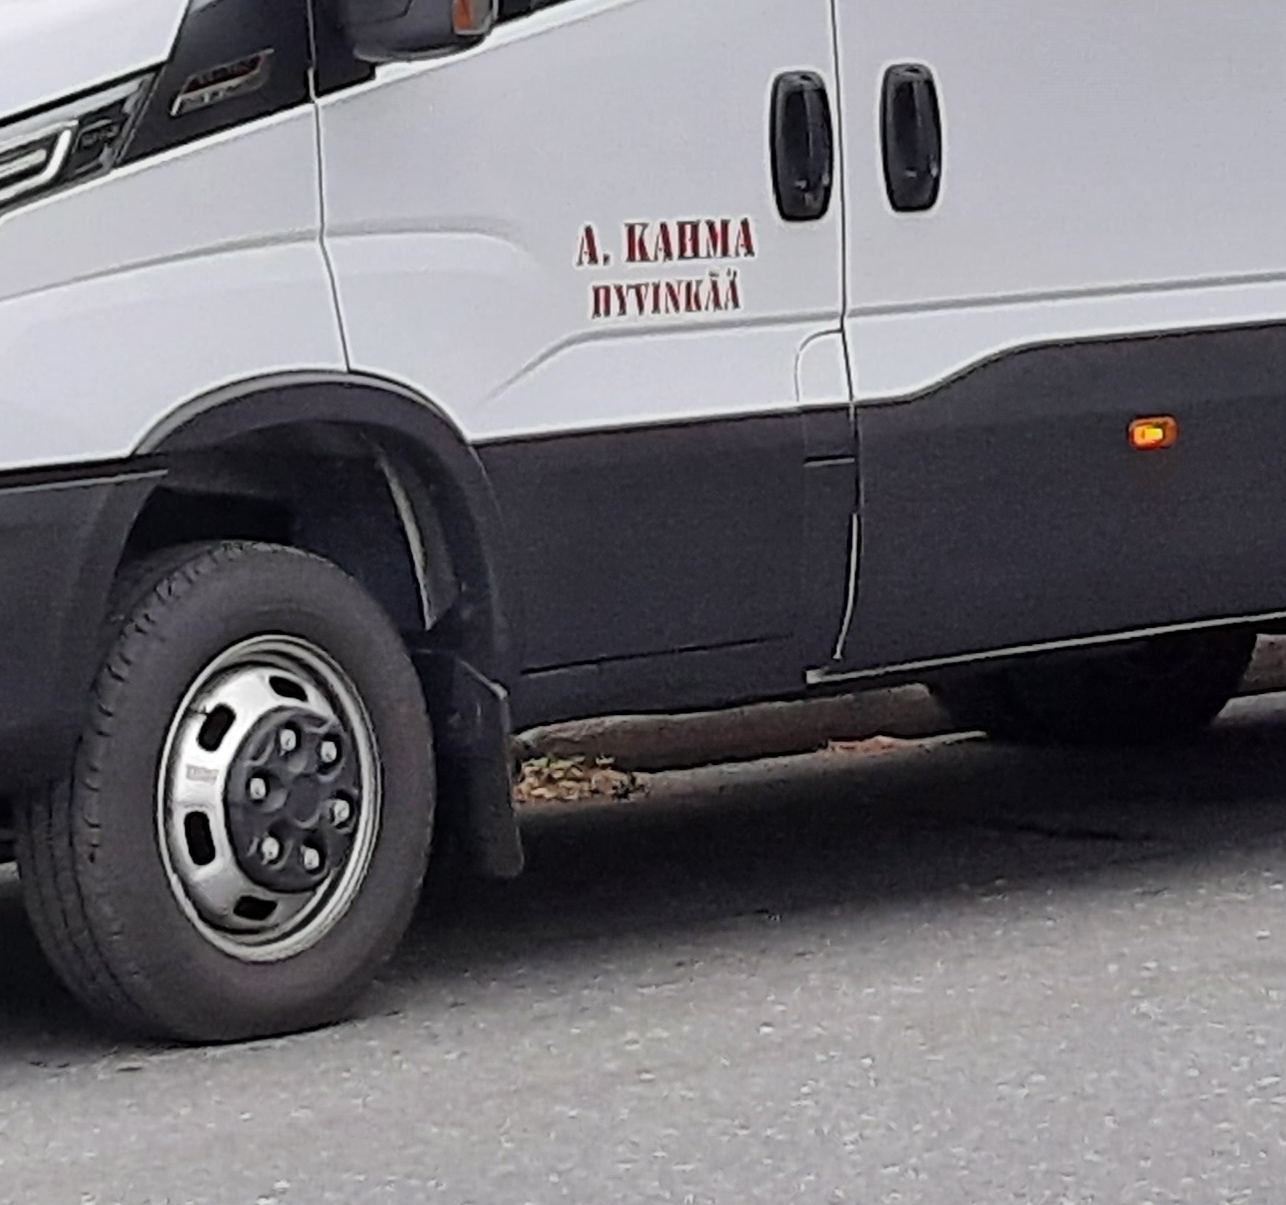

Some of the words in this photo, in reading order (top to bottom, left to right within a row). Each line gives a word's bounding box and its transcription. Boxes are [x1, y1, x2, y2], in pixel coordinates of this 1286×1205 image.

[577, 224, 610, 266] A.
[624, 217, 755, 263] KAHMA
[591, 268, 741, 319] HYVINKÄÄ
